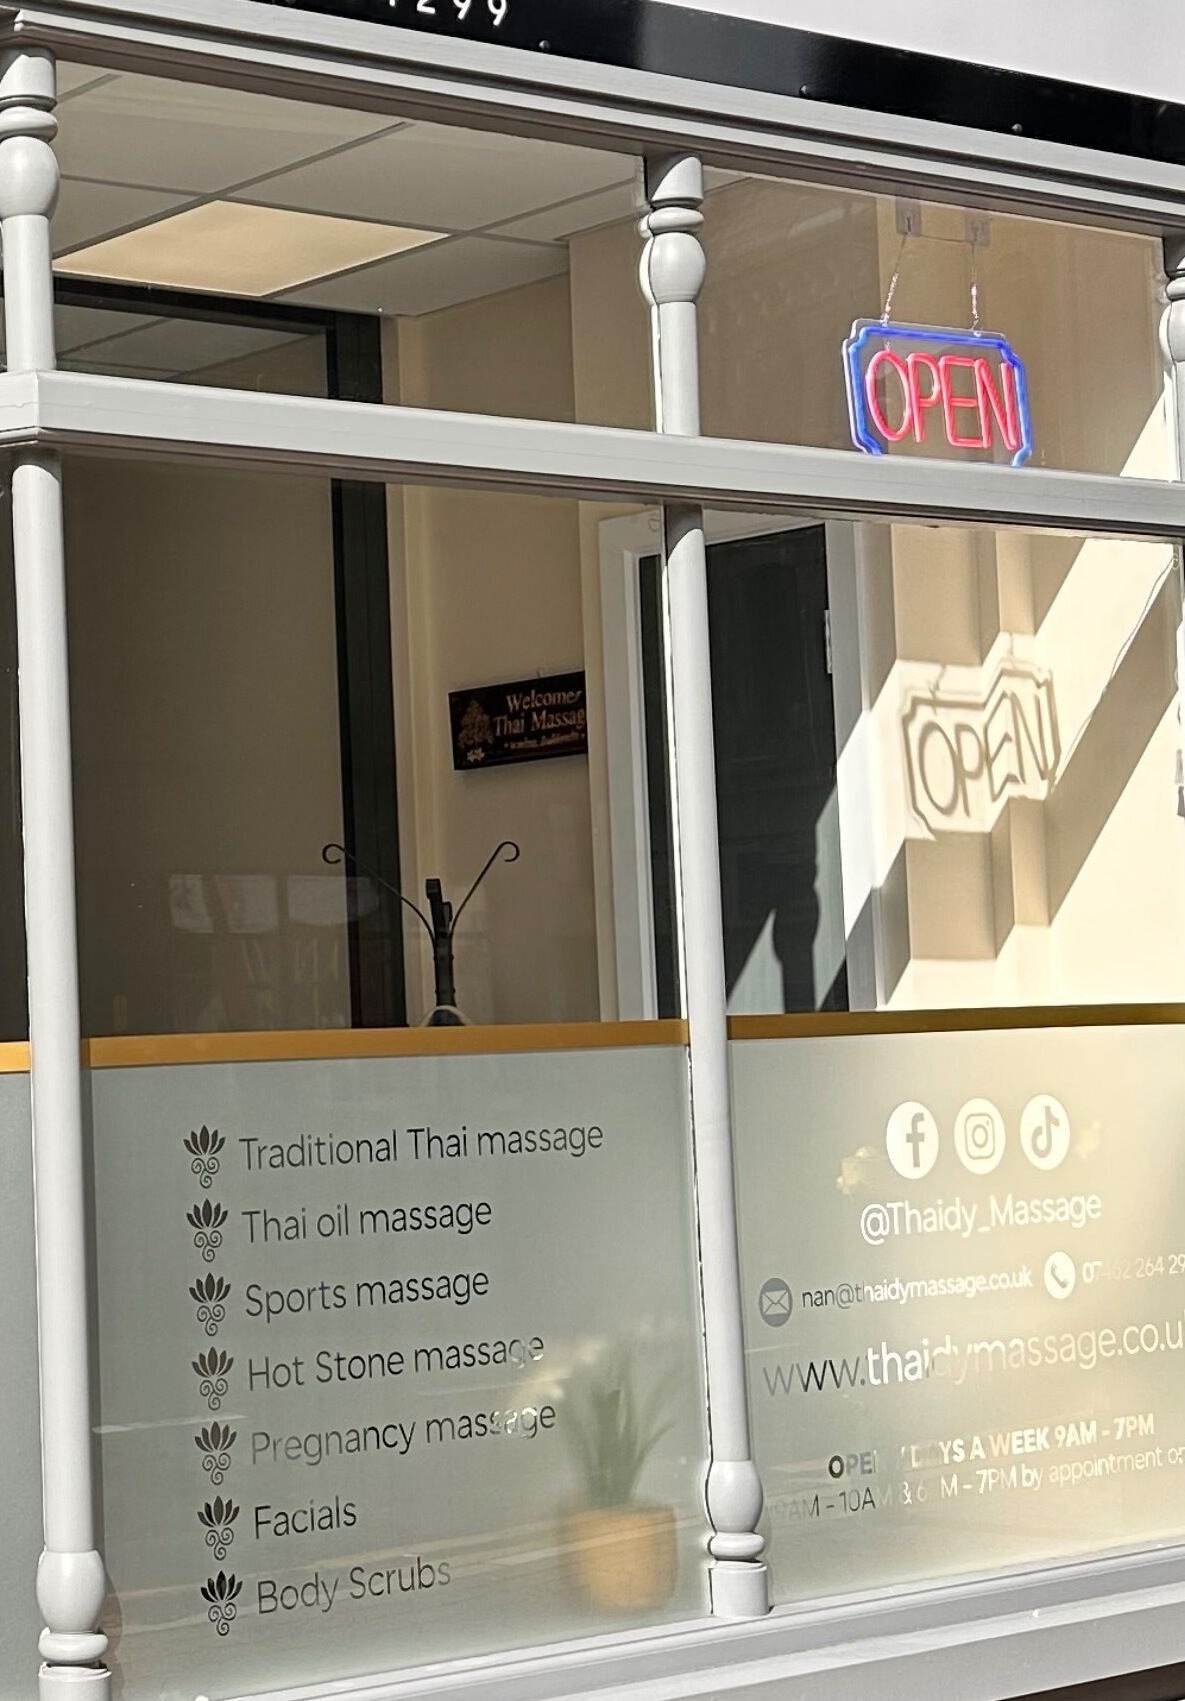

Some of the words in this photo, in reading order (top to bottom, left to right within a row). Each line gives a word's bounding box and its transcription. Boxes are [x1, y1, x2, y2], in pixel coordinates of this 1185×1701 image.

[867, 350, 1019, 450] OPEN
[493, 713, 525, 736] Thai
[506, 690, 583, 712] Welcome
[238, 1128, 398, 1171] Traditional
[407, 1125, 468, 1161] Thai
[477, 1124, 604, 1158] massage
[242, 1208, 308, 1243] Thai
[317, 1203, 349, 1239] oil
[359, 1201, 493, 1235] massage
[860, 1191, 1103, 1246] @Thaidy_Massage
[245, 1284, 347, 1323] Sports
[356, 1271, 490, 1306] massage
[801, 1264, 1034, 1310] nan@thaidymassage.co.uk
[1135, 1255, 1164, 1279] 264
[247, 1355, 306, 1391] Hot
[315, 1348, 405, 1385] Stone
[414, 1335, 545, 1372] massage
[763, 1311, 1185, 1396] www.thaidymassage.co.u
[251, 1421, 416, 1466] Pregnancy
[425, 1403, 556, 1444] massage
[828, 1449, 884, 1480] OPE
[910, 1438, 966, 1468] DYS
[969, 1434, 986, 1461] A
[989, 1426, 1050, 1459] WEEK
[1054, 1420, 1097, 1449] 9AM
[1114, 1413, 1155, 1440] 7PM
[916, 1473, 958, 1502] 6M
[977, 1466, 1018, 1495] 7PM
[1021, 1462, 1044, 1491] by
[1049, 1445, 1163, 1485] appointment
[253, 1495, 358, 1539] Facials
[257, 1569, 339, 1615] Body
[349, 1556, 452, 1600] Scrubs
